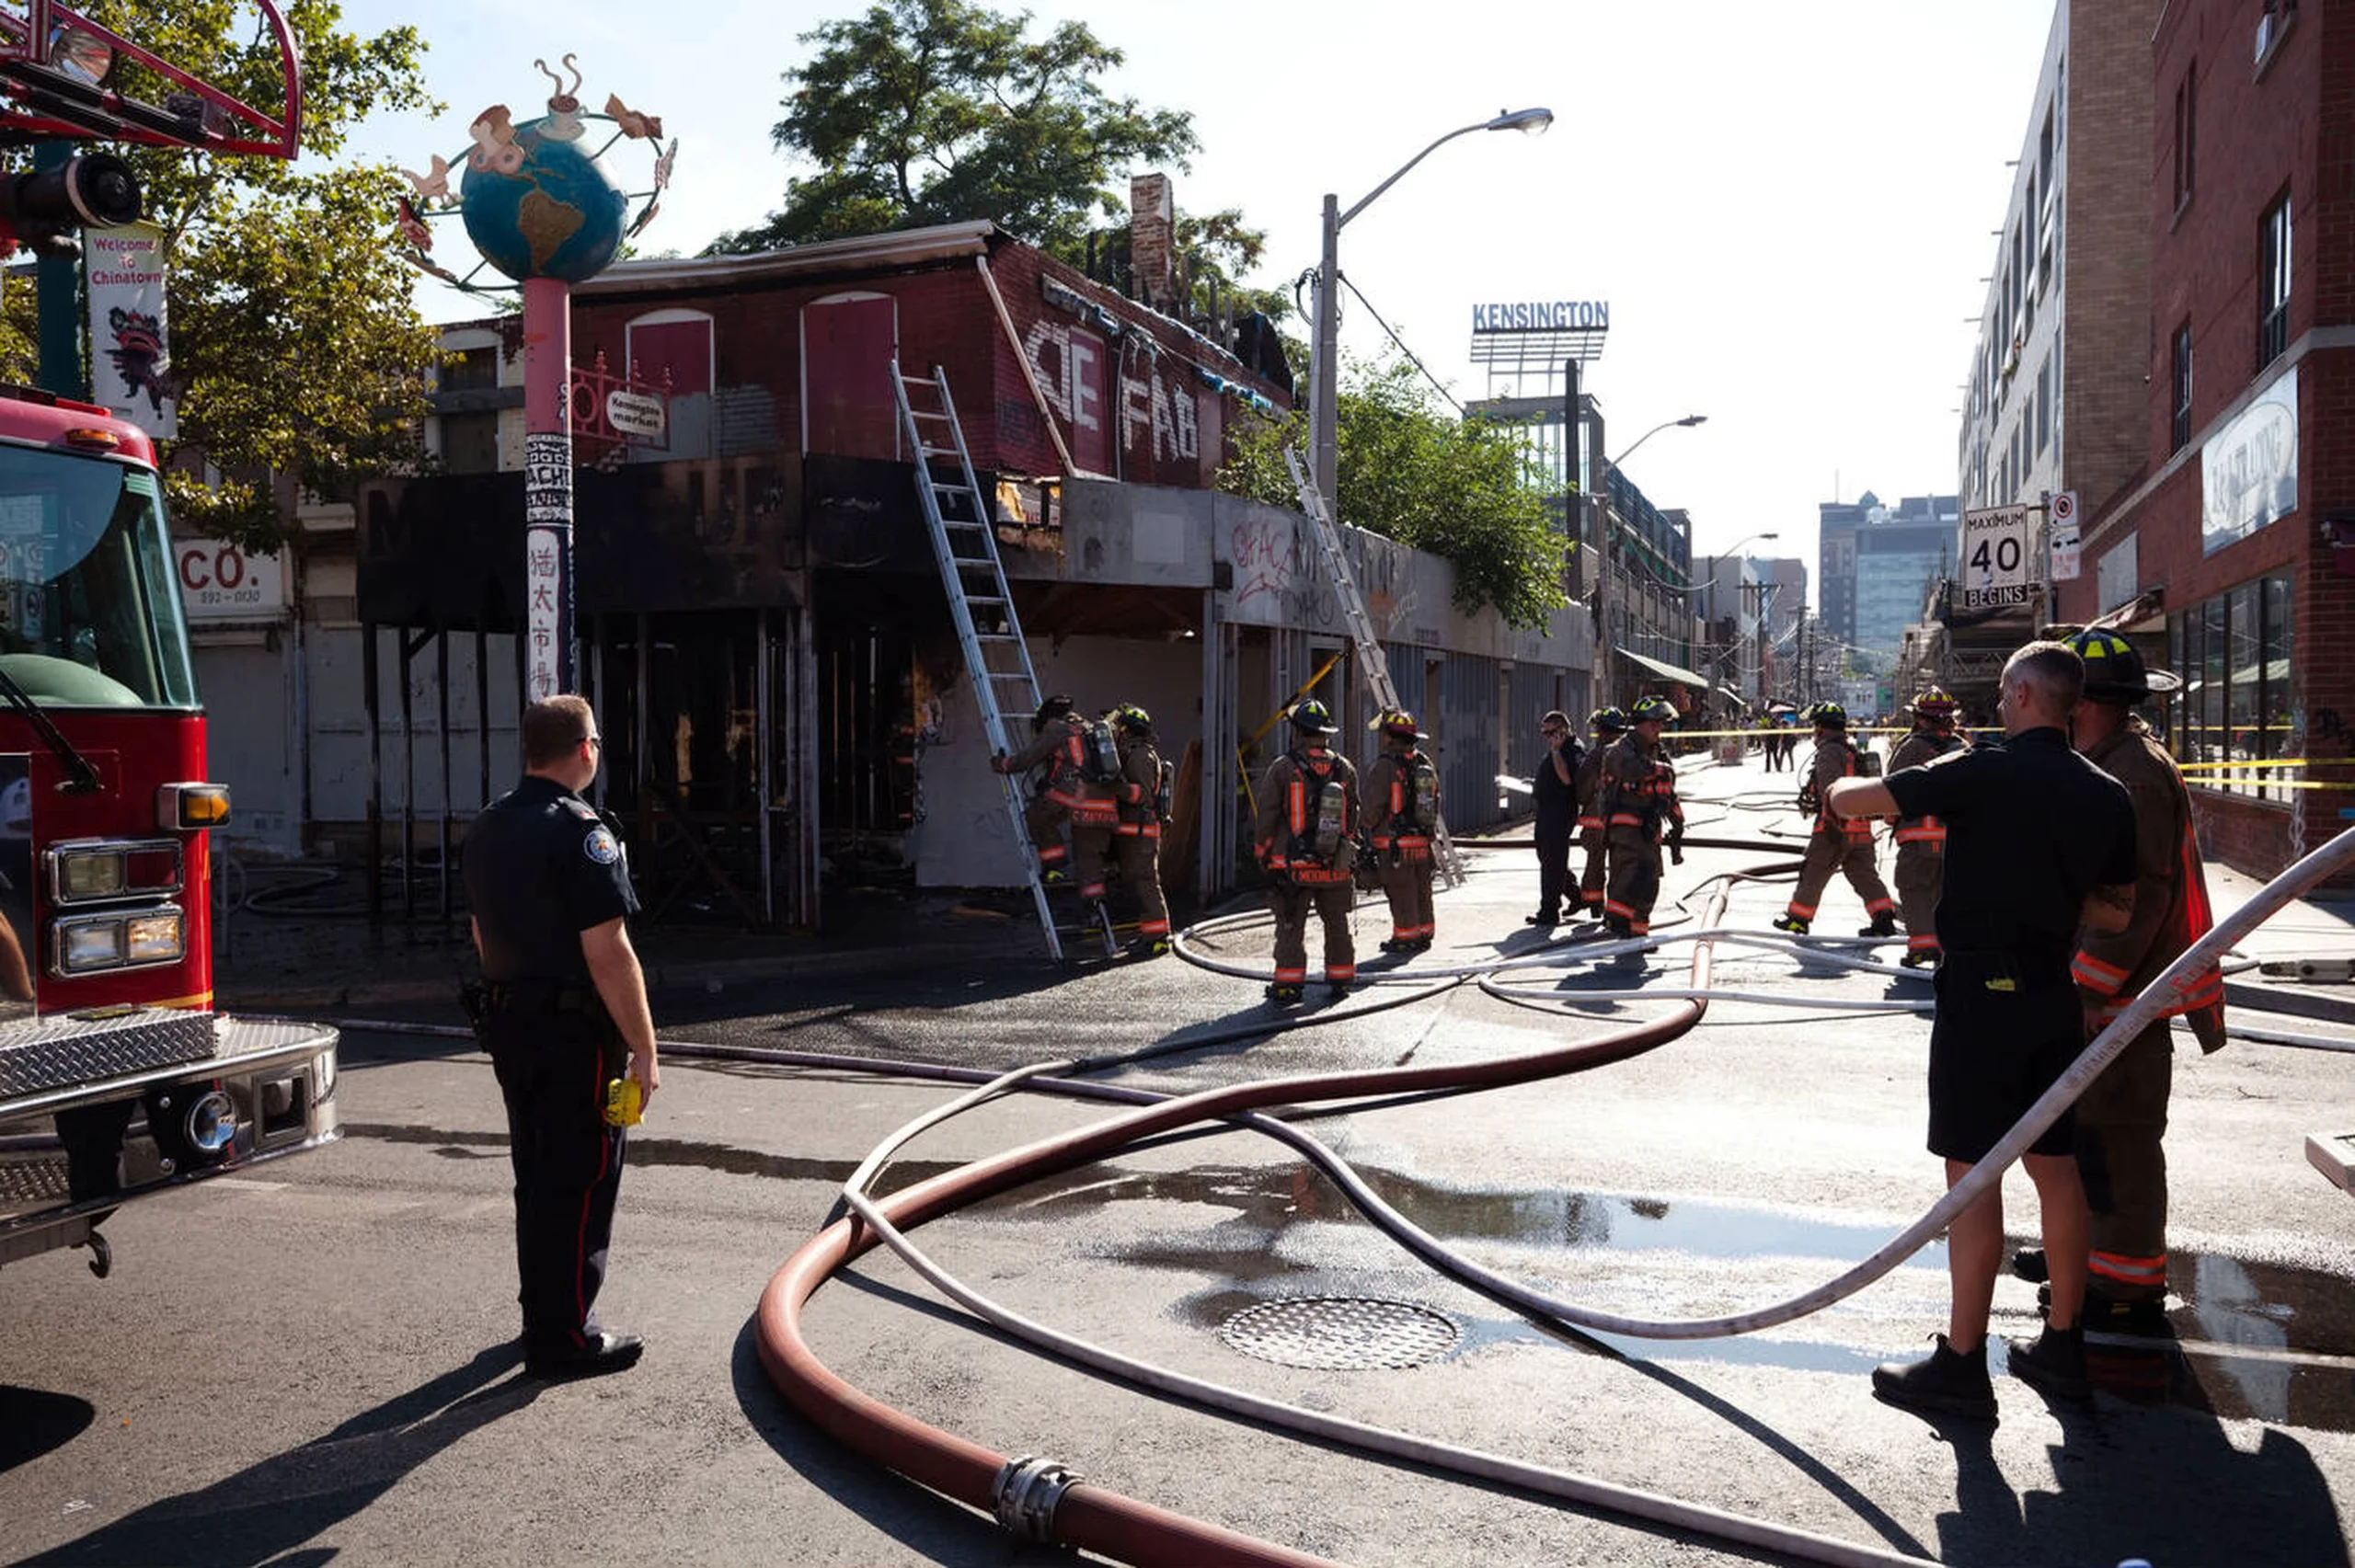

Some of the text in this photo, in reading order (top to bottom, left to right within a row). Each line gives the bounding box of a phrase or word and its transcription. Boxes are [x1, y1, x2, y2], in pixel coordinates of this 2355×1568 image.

[94, 237, 155, 252] Welcome
[92, 270, 162, 285] Chinatown
[1473, 302, 1608, 329] KENSINGTON
[1968, 512, 2024, 531] MAXIMUM
[1970, 537, 2021, 572] 40
[181, 549, 258, 589] CO.
[1970, 586, 2023, 605] BEGINS
